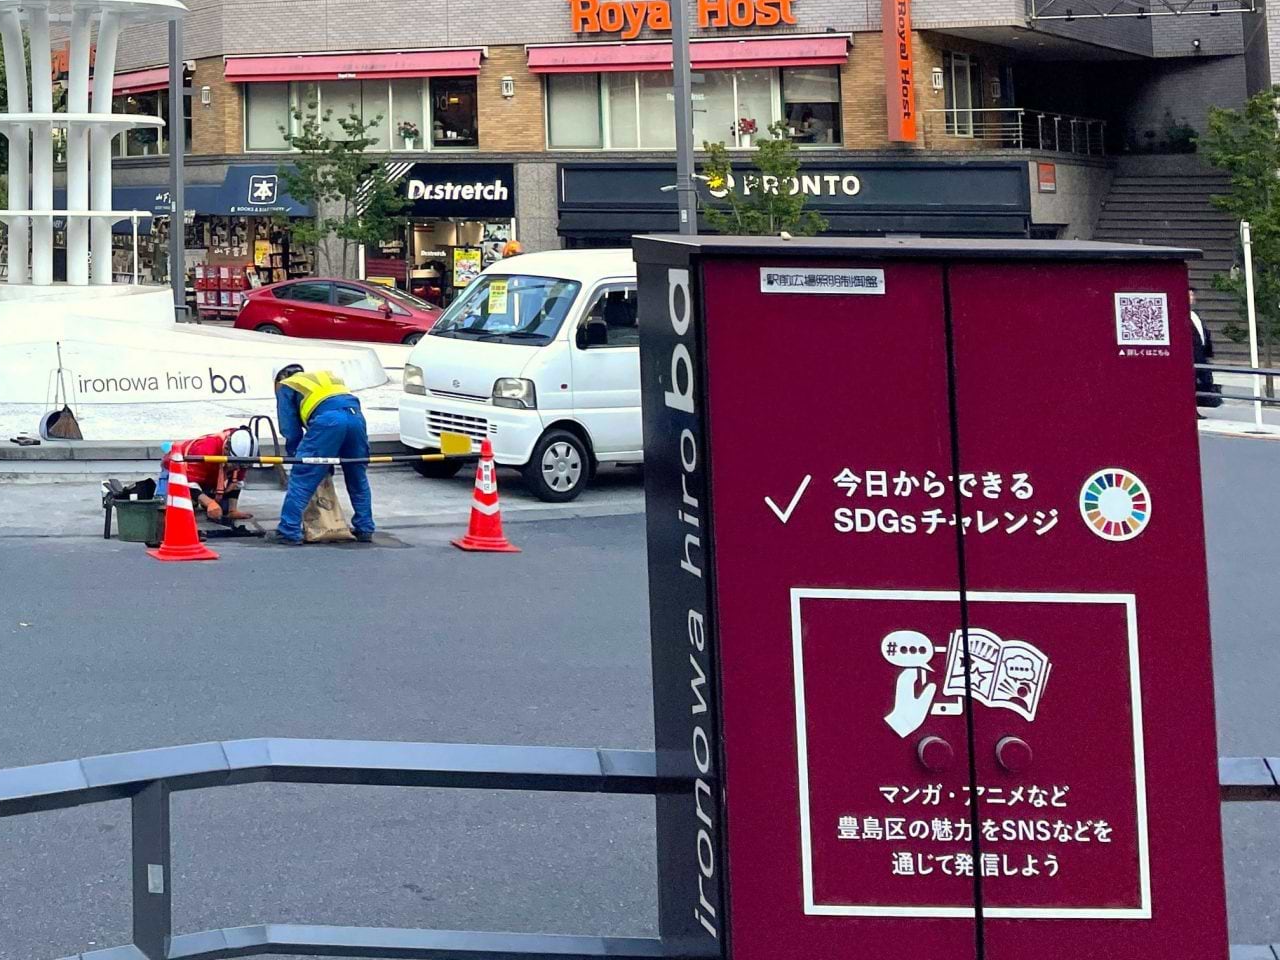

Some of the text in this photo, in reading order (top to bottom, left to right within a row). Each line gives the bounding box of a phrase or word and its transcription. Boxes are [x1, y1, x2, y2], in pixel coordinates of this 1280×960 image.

[898, 0, 911, 120] Royal Host
[252, 180, 273, 201] 本
[407, 179, 508, 201] Dr.stretch
[78, 367, 247, 394] ironowa hiro ba
[832, 467, 1034, 500] 今日からできる
[664, 267, 718, 939] ironowa hiro ba
[837, 815, 1114, 843] 豊島区の魅力をSNSなどを
[891, 851, 1061, 878] 通じて発信しよう
